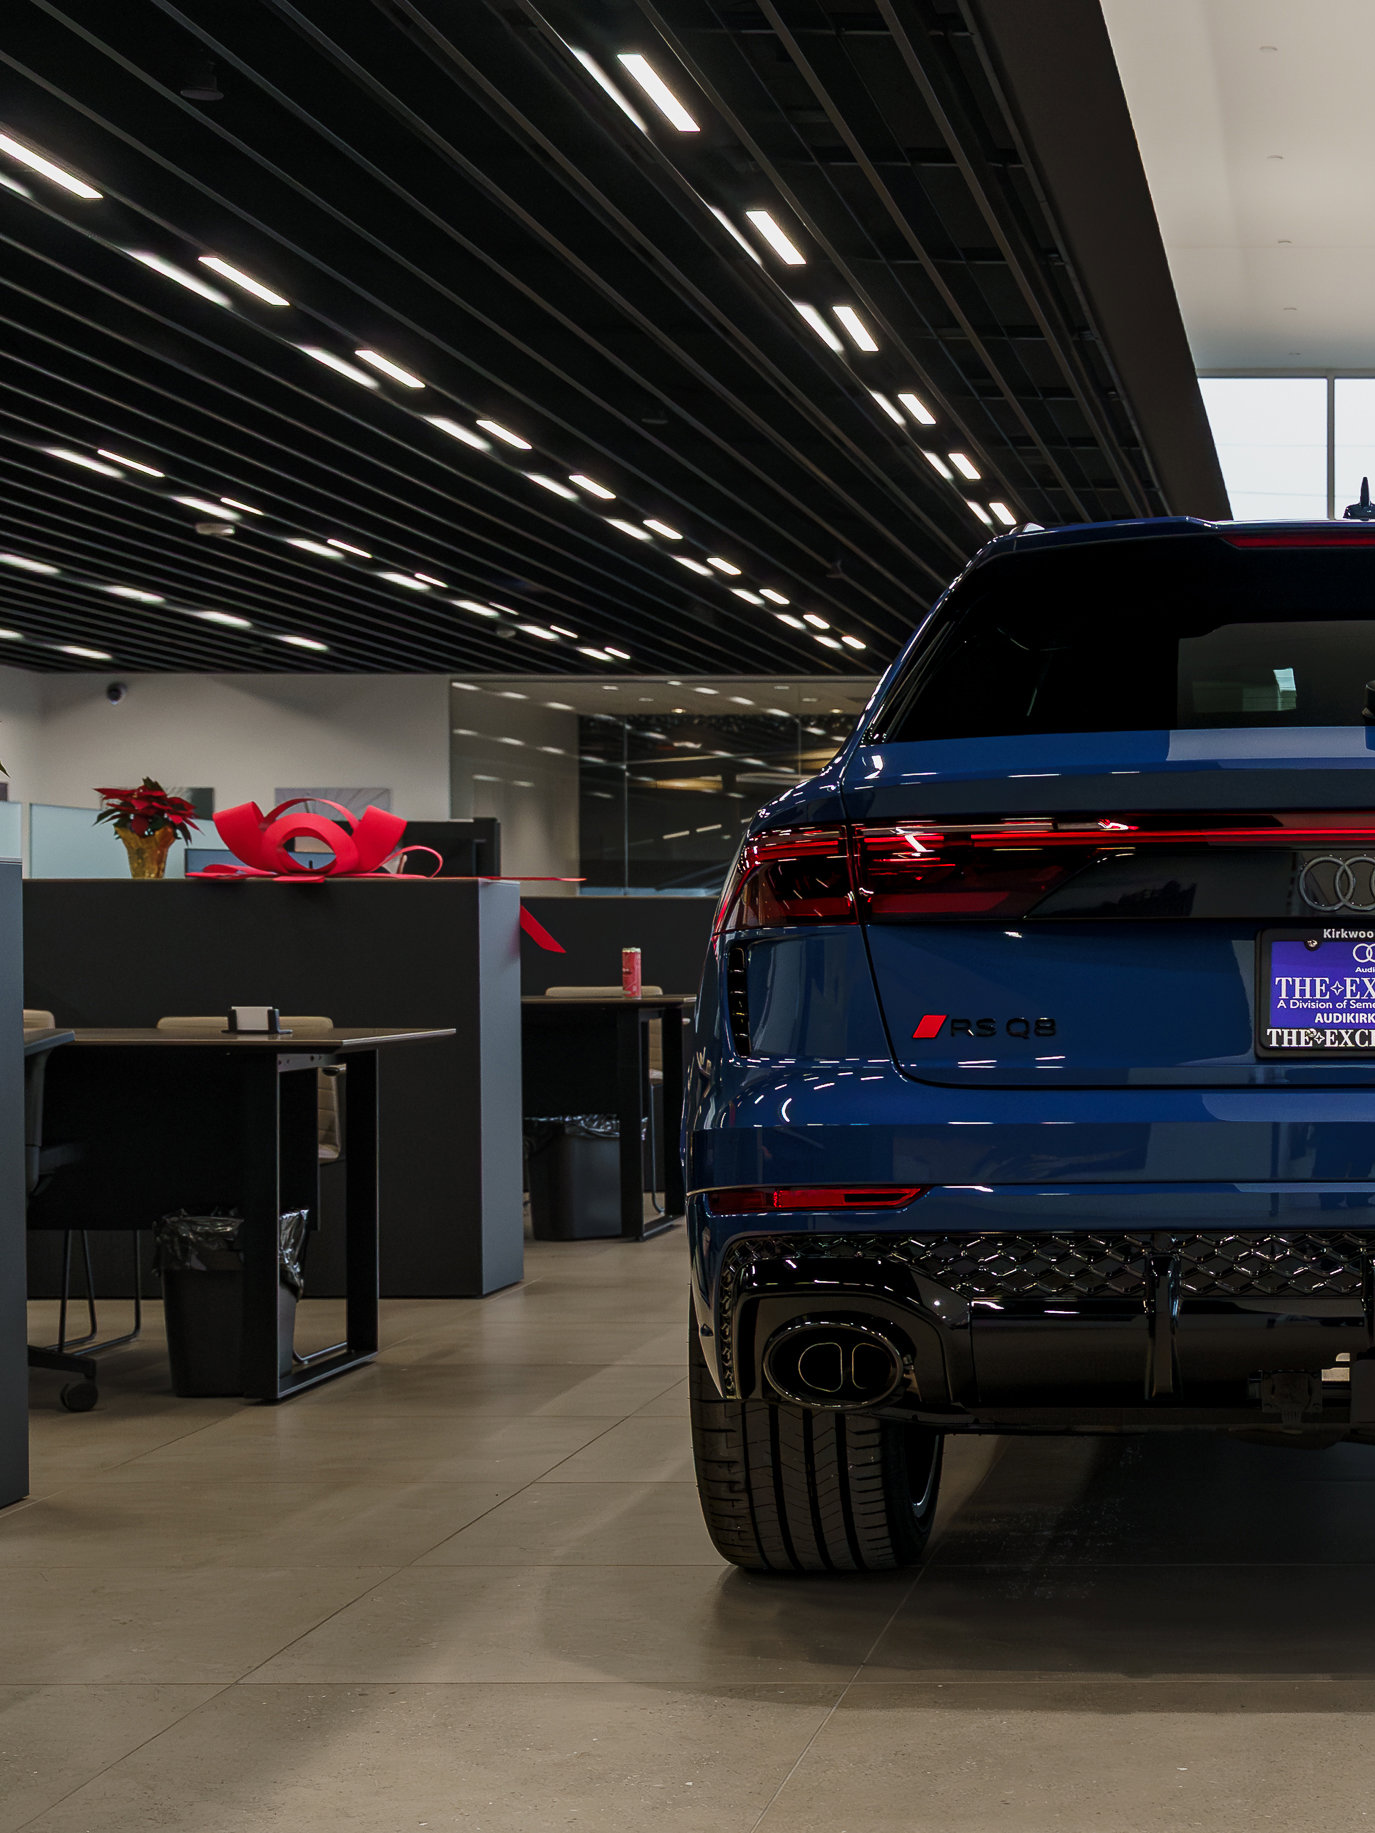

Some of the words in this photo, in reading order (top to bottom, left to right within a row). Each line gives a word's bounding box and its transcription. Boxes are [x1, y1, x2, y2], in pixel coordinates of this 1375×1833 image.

[1275, 977, 1330, 999] THE
[1277, 1000, 1287, 1009] A
[1290, 1000, 1333, 1009] Division
[1336, 1000, 1348, 1009] of
[950, 1018, 997, 1037] RS
[1006, 1017, 1056, 1039] Q8
[1266, 1029, 1313, 1047] THE
